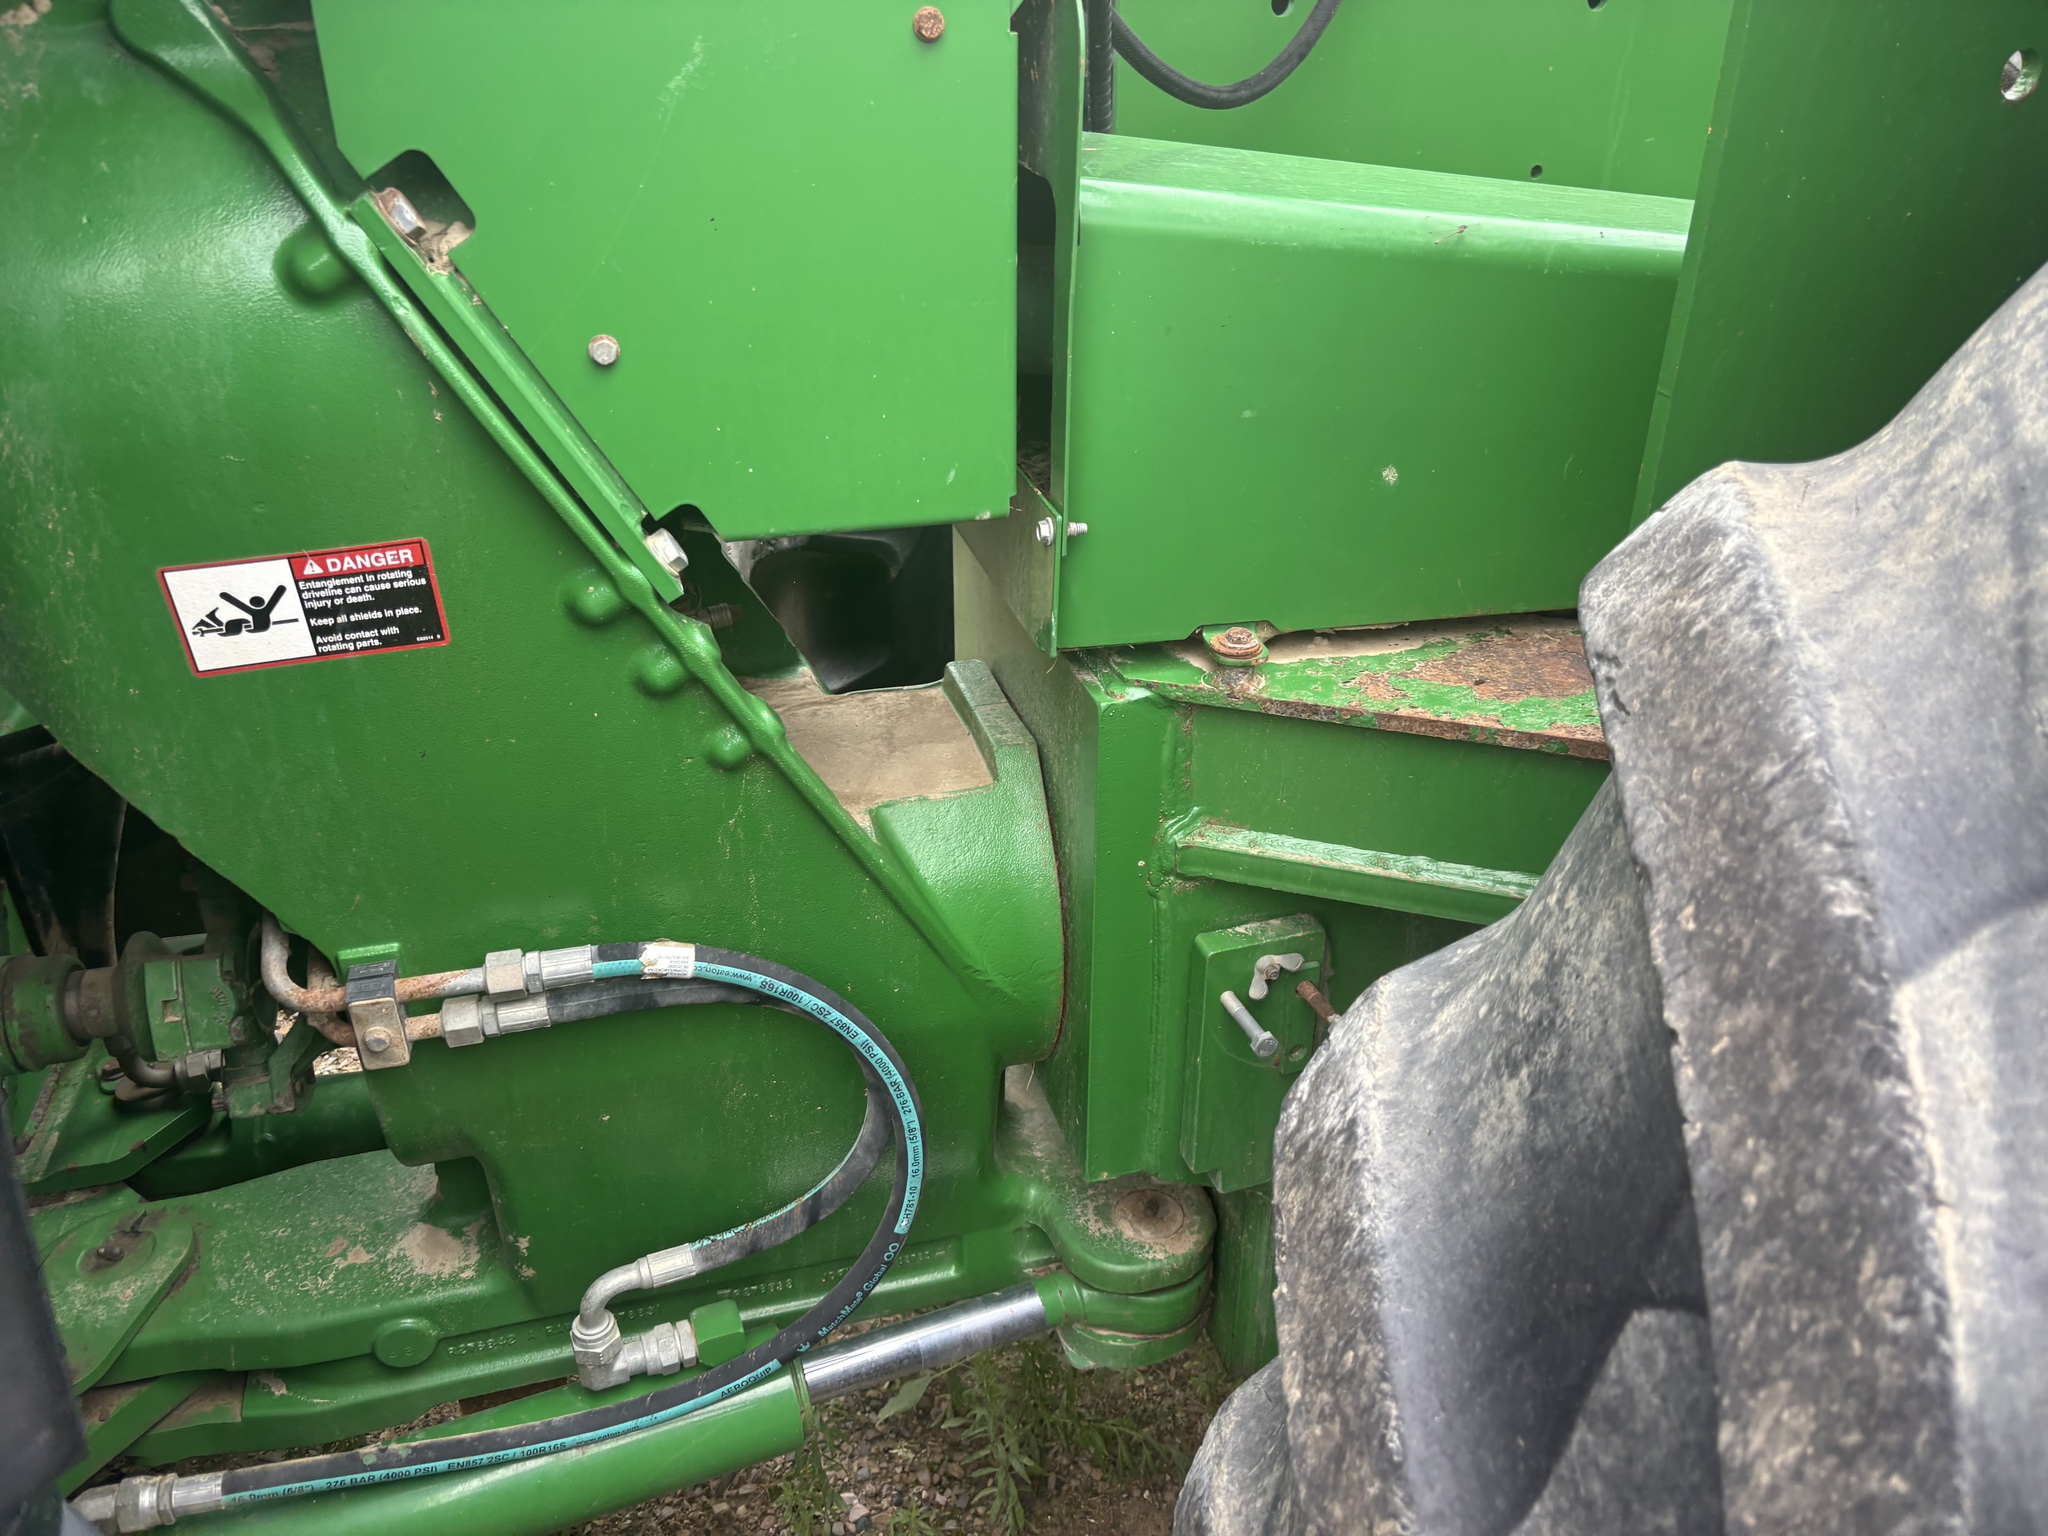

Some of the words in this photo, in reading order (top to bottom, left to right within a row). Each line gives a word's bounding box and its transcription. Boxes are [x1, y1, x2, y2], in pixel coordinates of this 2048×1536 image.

[326, 549, 414, 573] DANGER
[298, 574, 365, 590] Entanglement
[366, 573, 375, 582] in
[377, 570, 413, 581] rotating
[301, 586, 343, 599] driveline
[344, 584, 362, 594] can
[363, 582, 391, 593] cause
[393, 577, 427, 589] serious
[304, 598, 332, 610] injury
[334, 597, 344, 605] or
[346, 593, 375, 604] death.
[309, 616, 335, 627] Keep
[336, 614, 348, 624] all
[349, 610, 383, 622] shields
[384, 609, 394, 618] in
[395, 606, 422, 618] place.
[315, 632, 342, 644] Avoid
[344, 629, 379, 640] contact
[380, 626, 400, 636] with
[317, 641, 355, 653] rotating
[356, 638, 382, 650] parts.
[693, 964, 753, 982] www.eaton.co
[759, 980, 804, 1004] 100R16S
[810, 1003, 833, 1019] 2SC
[829, 1016, 859, 1040] EN857
[889, 1078, 906, 1099] BAR
[899, 1099, 912, 1116] 276
[863, 1264, 888, 1291] Global
[720, 1366, 772, 1399] AEROQUIP
[325, 1479, 346, 1490] 276
[349, 1474, 376, 1485] BAR
[379, 1469, 411, 1482] (4000
[414, 1465, 438, 1476] PSI)
[447, 1458, 483, 1470] EN857
[486, 1453, 510, 1464] 2SC
[520, 1441, 567, 1458] 100R16S
